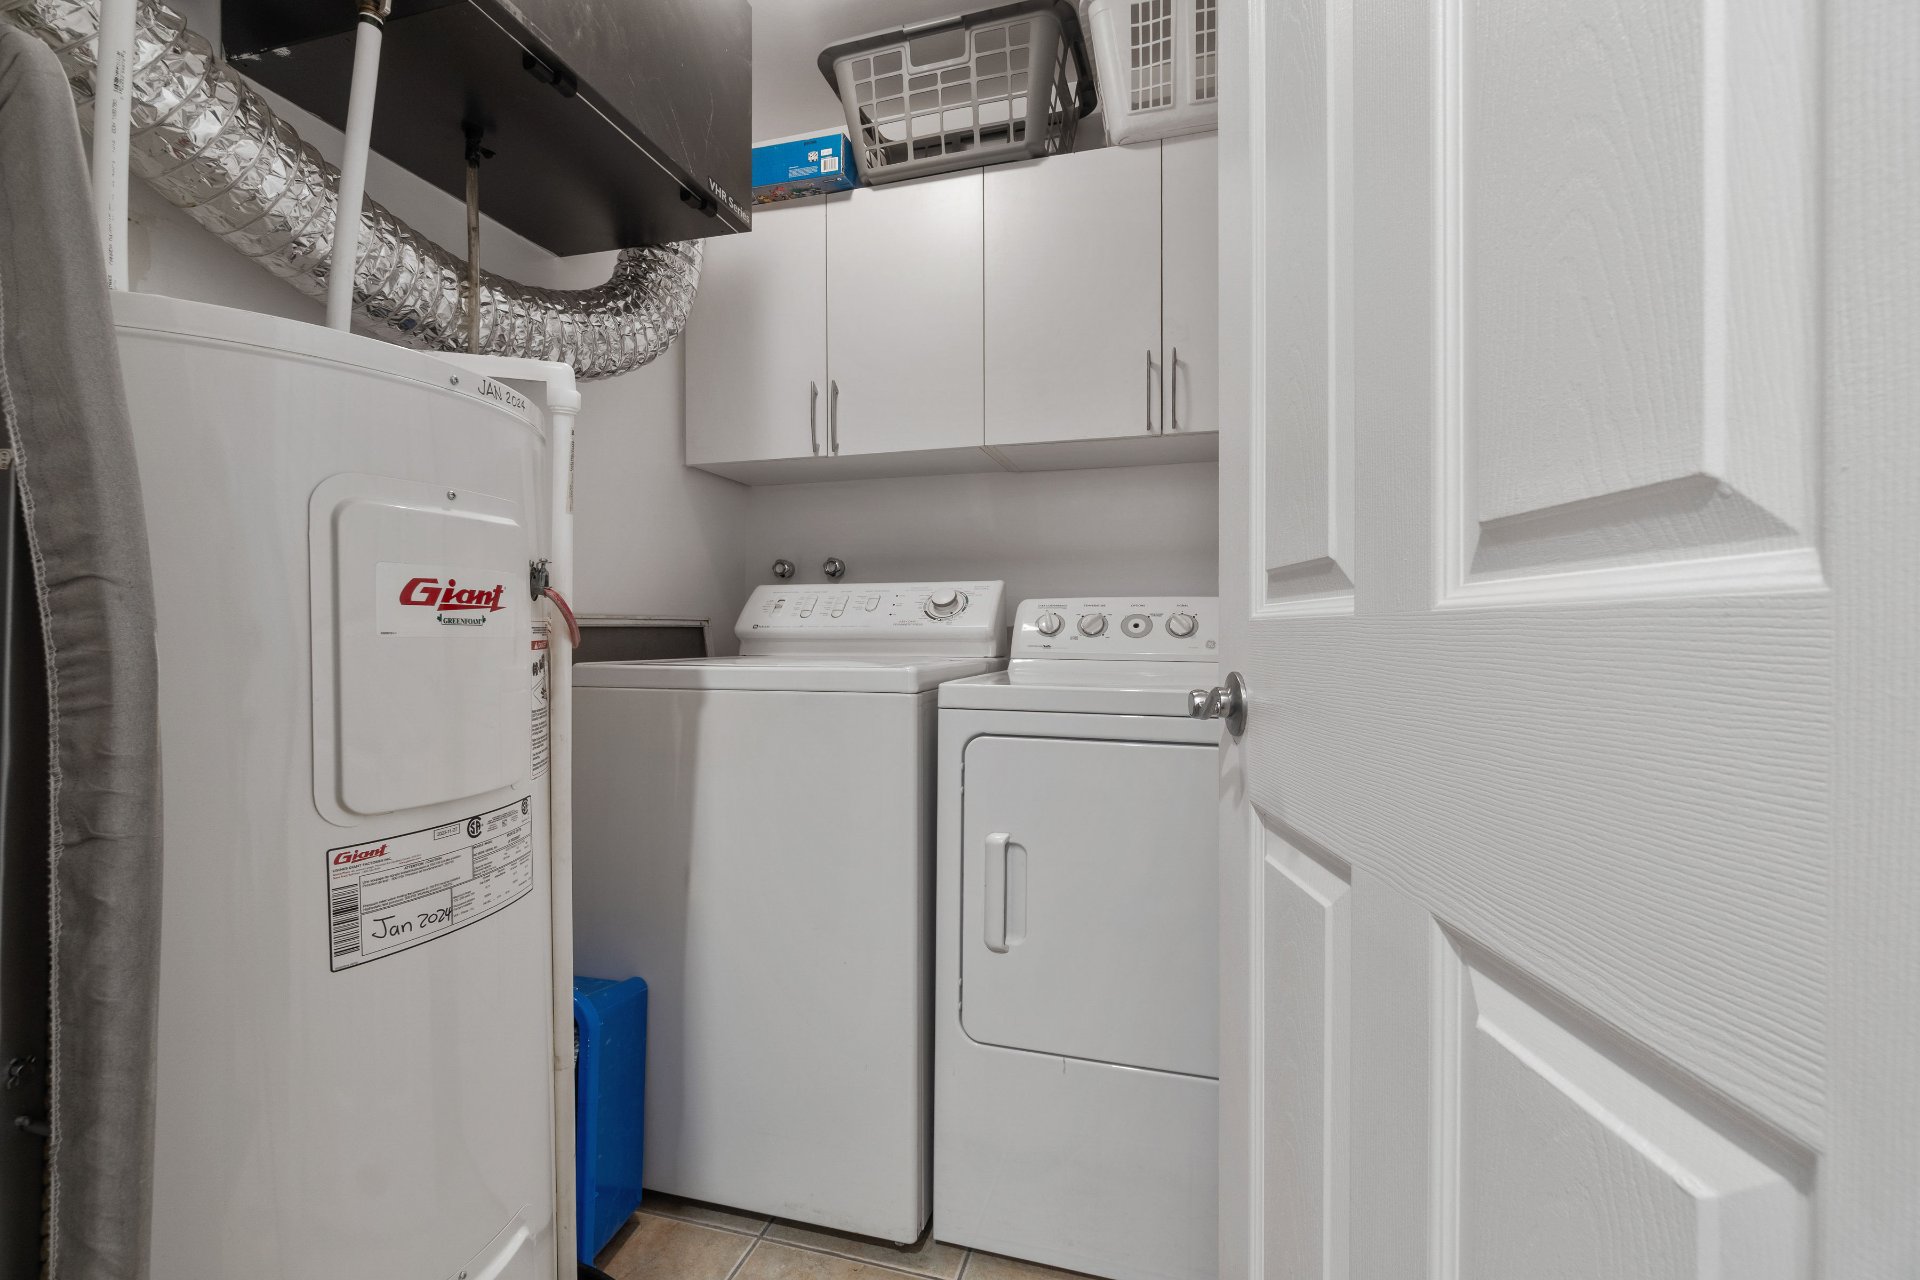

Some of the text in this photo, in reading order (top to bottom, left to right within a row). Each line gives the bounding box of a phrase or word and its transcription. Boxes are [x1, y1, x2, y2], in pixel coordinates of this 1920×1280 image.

[709, 177, 750, 223] VHR Series
[478, 379, 526, 412] JAN 2024
[399, 577, 507, 612] Giant
[443, 617, 482, 625] GREENFOAM
[333, 843, 388, 866] Giant
[371, 906, 454, 939] Jan 2024
